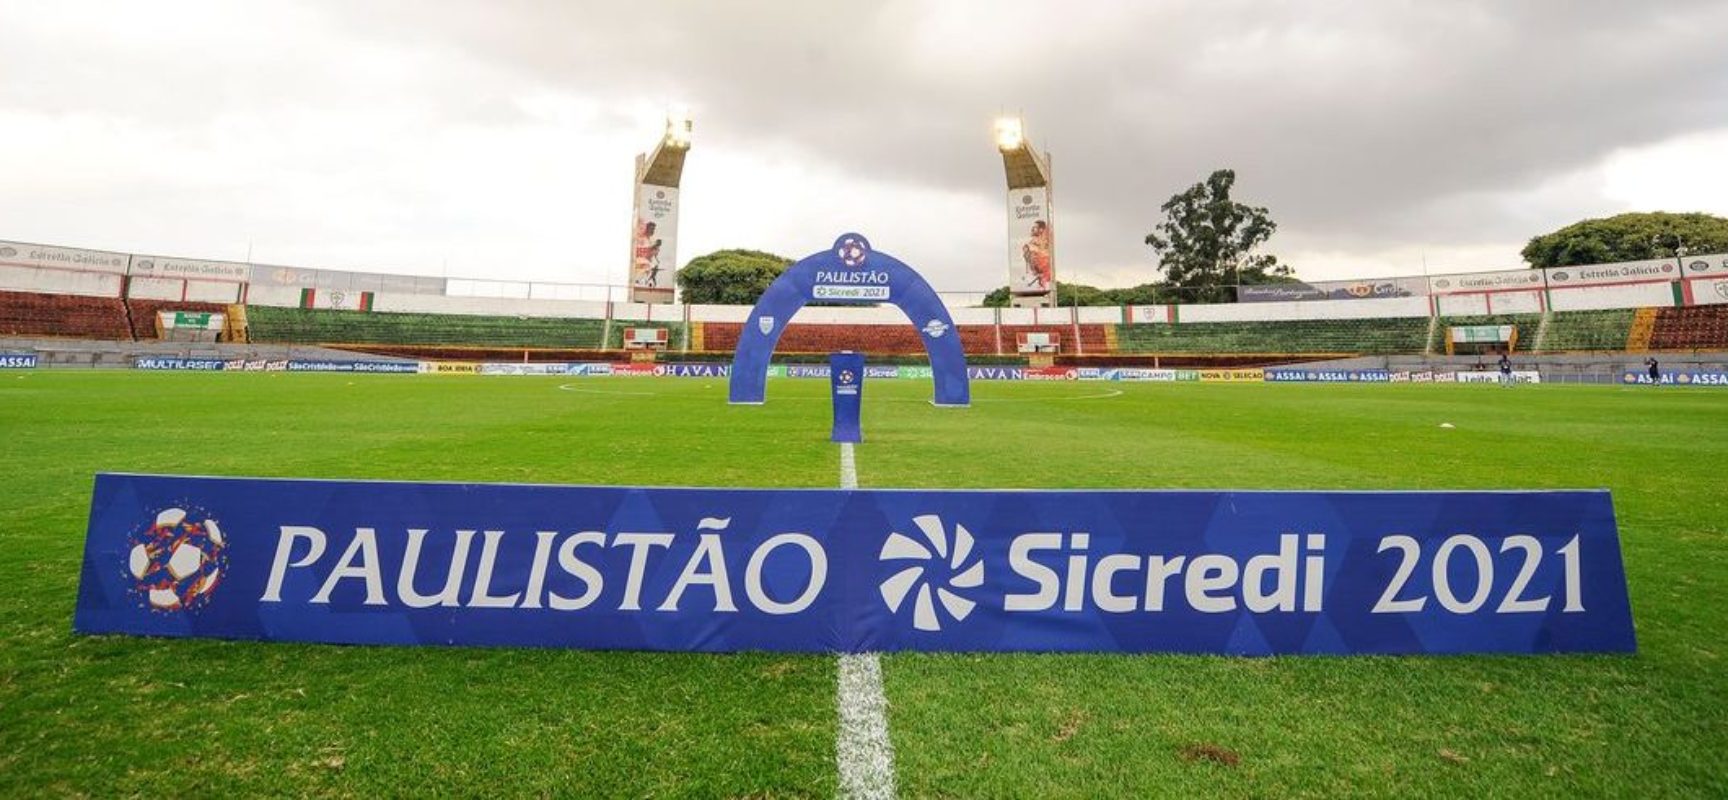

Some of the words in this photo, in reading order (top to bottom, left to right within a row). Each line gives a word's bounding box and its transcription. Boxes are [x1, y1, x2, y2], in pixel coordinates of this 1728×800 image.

[30, 250, 71, 263] Estrella
[815, 270, 889, 284] PAULISTÃO
[1579, 268, 1619, 280] Estrella
[1620, 265, 1660, 278] Galicia
[828, 287, 860, 297] Sicredi
[863, 288, 886, 297] 2021
[666, 364, 728, 377] HAVAN
[869, 366, 898, 377] Sicredi
[259, 517, 829, 615] PAULISTÃO
[1003, 532, 1325, 613] Sicredi
[1370, 533, 1586, 614] 2021
